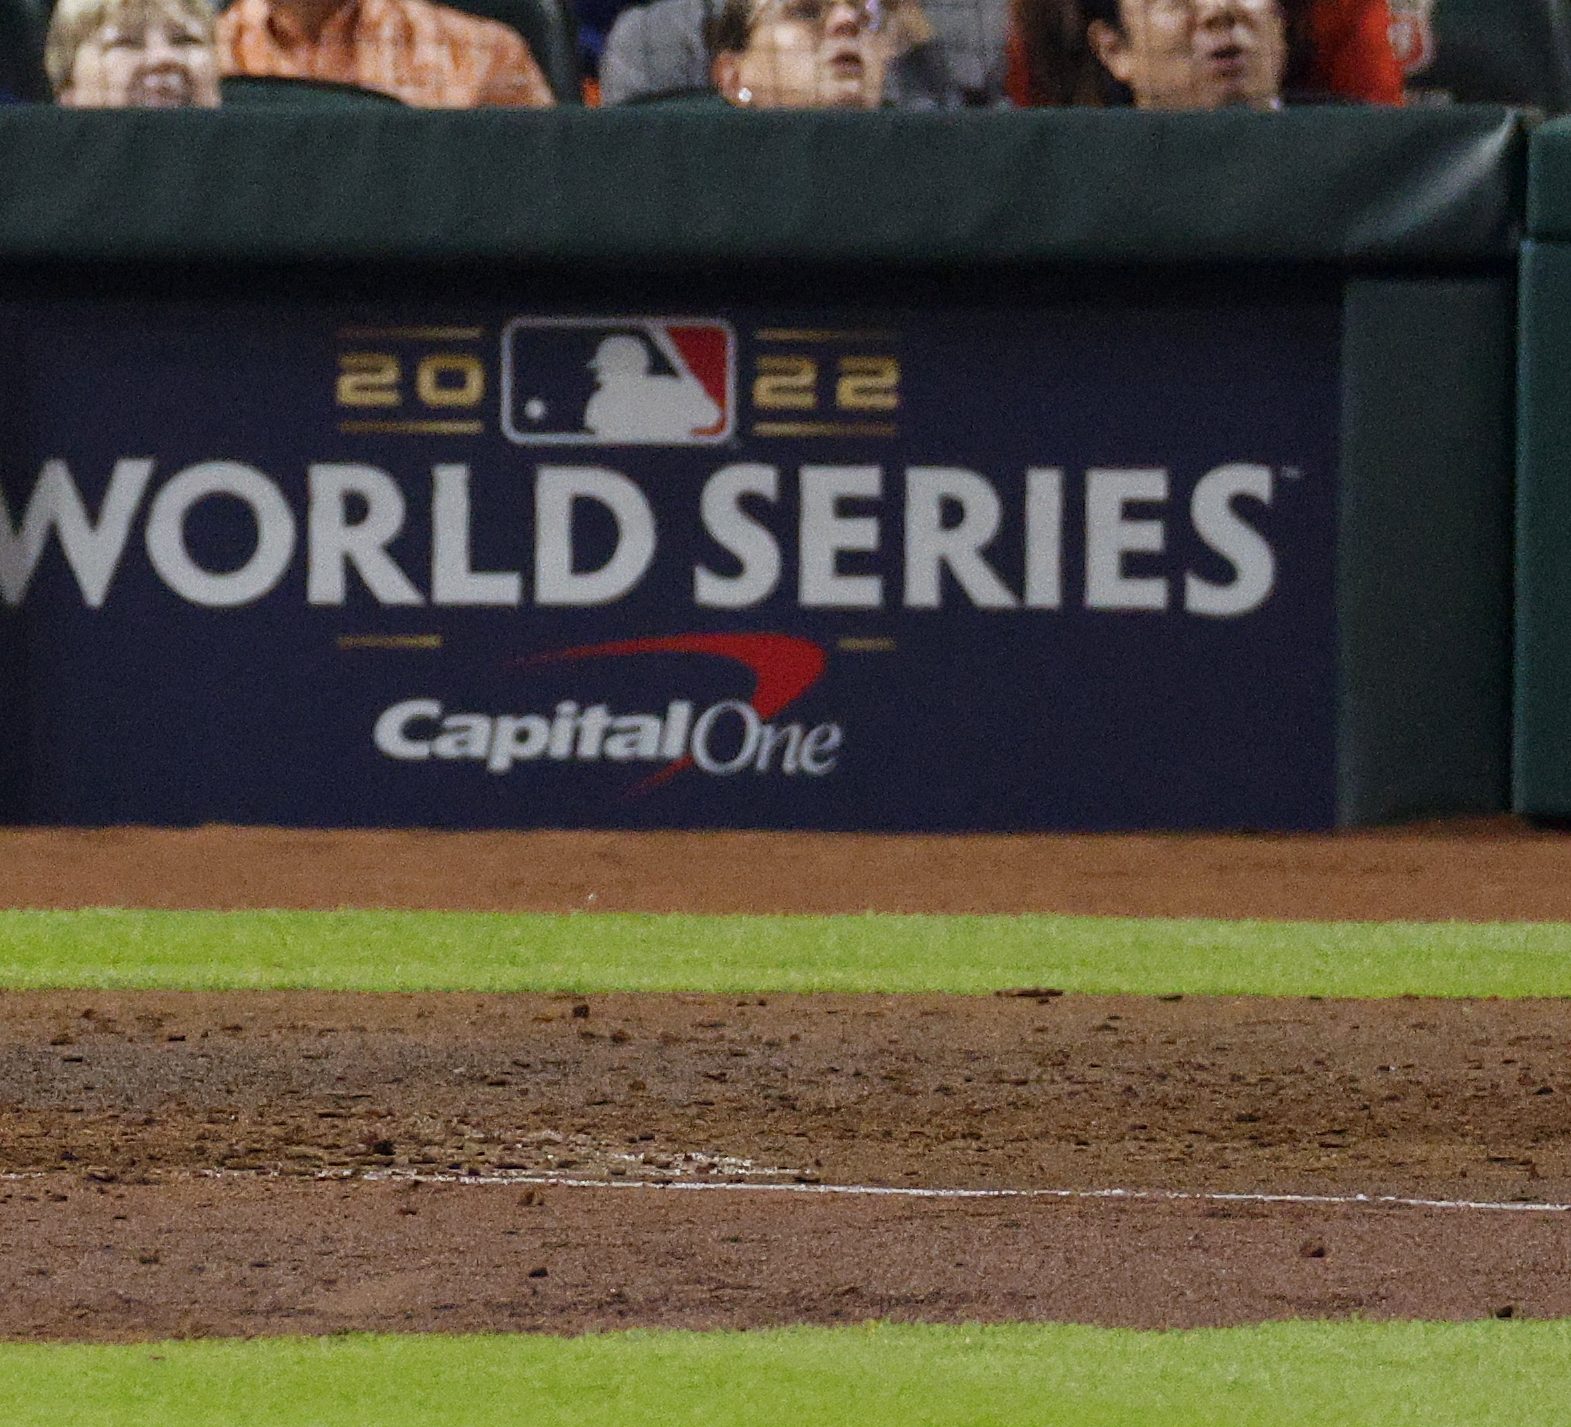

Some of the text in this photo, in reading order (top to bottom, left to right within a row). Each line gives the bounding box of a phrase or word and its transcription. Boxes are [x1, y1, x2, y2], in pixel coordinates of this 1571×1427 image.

[335, 352, 901, 411] 20 22
[693, 461, 1277, 618] SERIES
